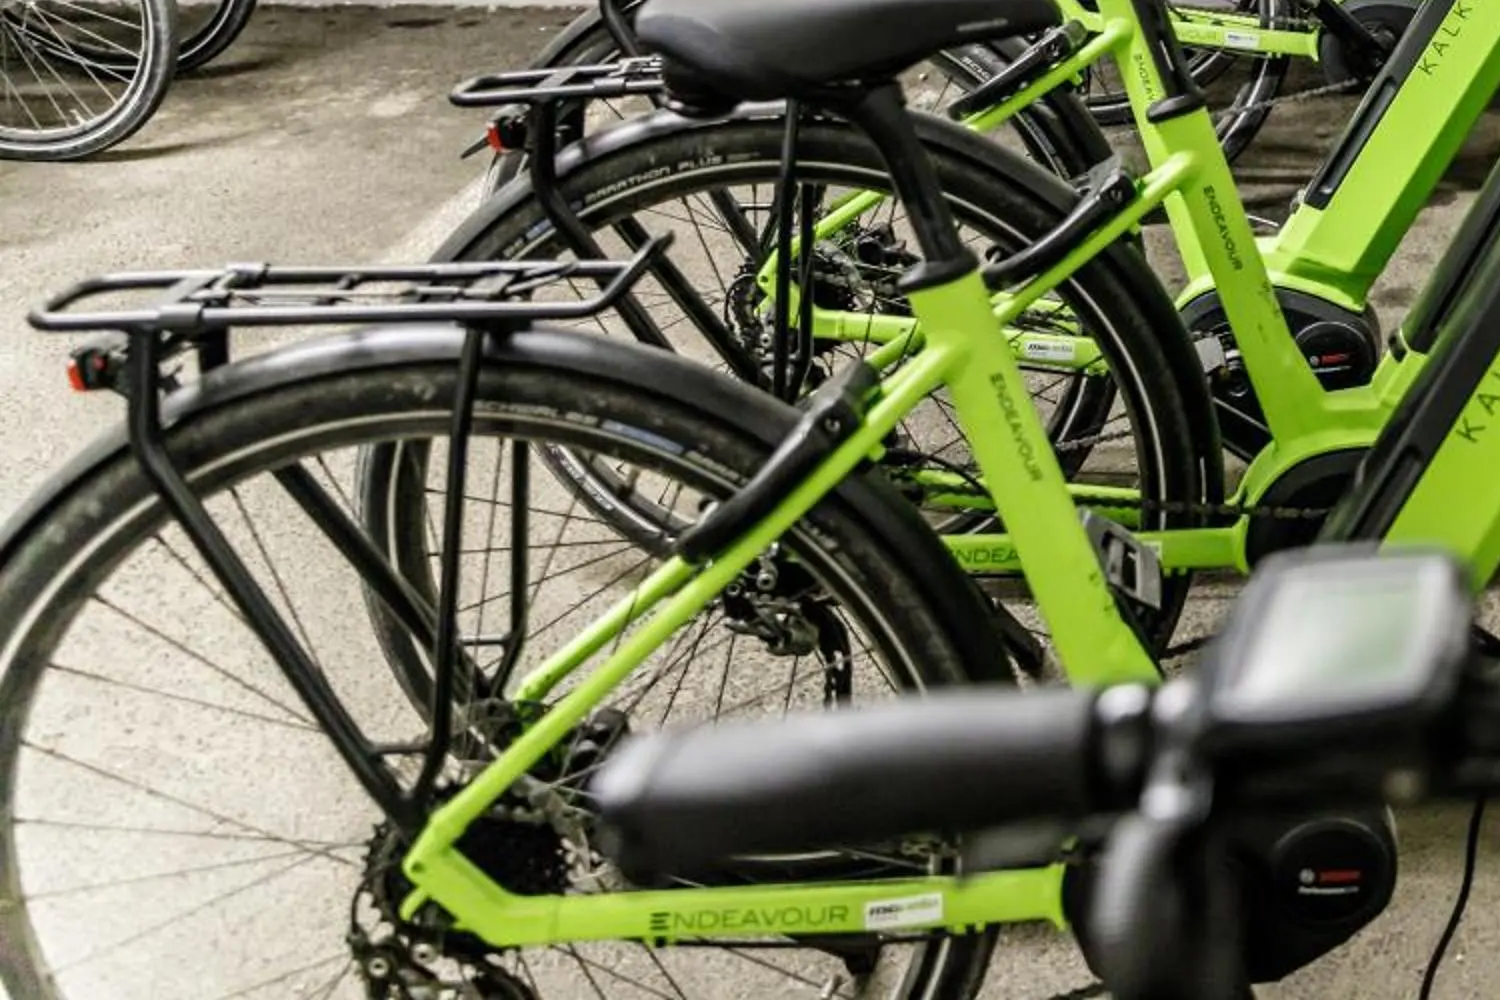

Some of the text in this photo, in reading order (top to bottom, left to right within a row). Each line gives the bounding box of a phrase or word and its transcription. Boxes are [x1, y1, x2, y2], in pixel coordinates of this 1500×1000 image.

[1203, 184, 1243, 271] ENDEAVOUR
[989, 371, 1043, 482] ENDEAVOUR
[650, 904, 850, 931] ENDEAVOUR
